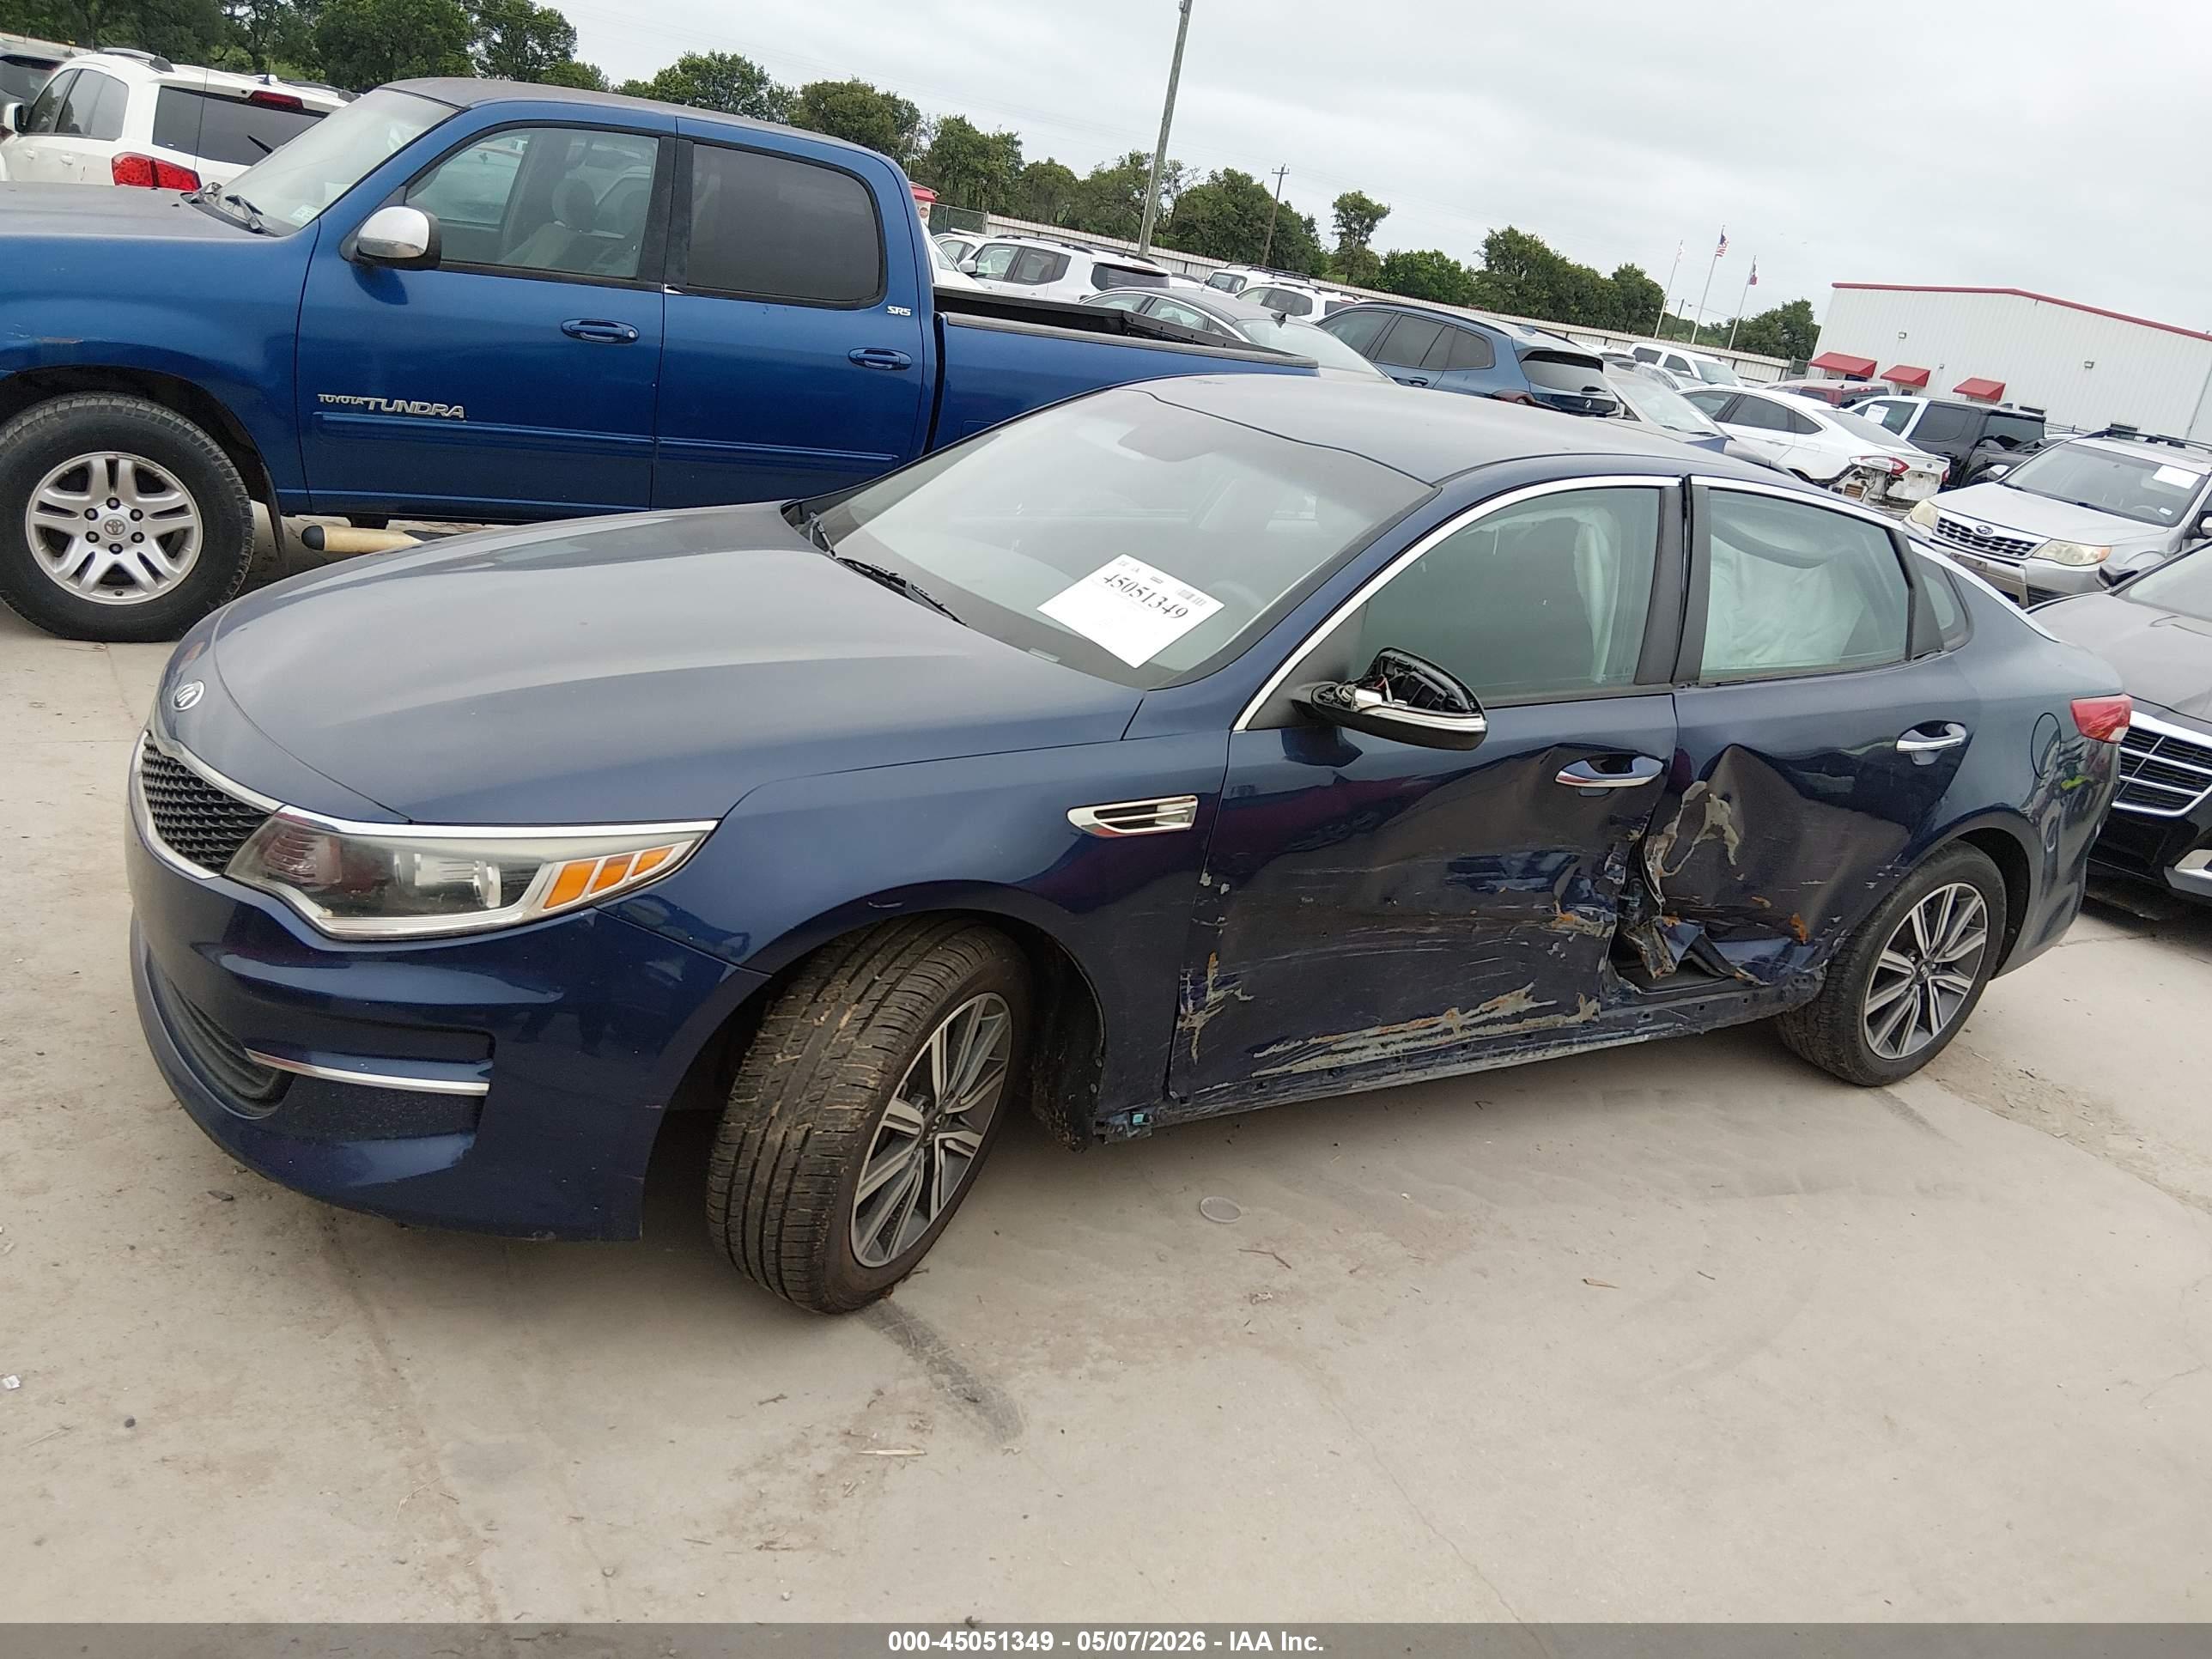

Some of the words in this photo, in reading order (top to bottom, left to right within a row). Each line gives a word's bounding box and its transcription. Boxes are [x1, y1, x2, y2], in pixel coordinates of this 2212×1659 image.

[317, 393, 364, 405] TOYOTA
[362, 397, 465, 419] TUNDRA
[1103, 573, 1189, 619] 45051349
